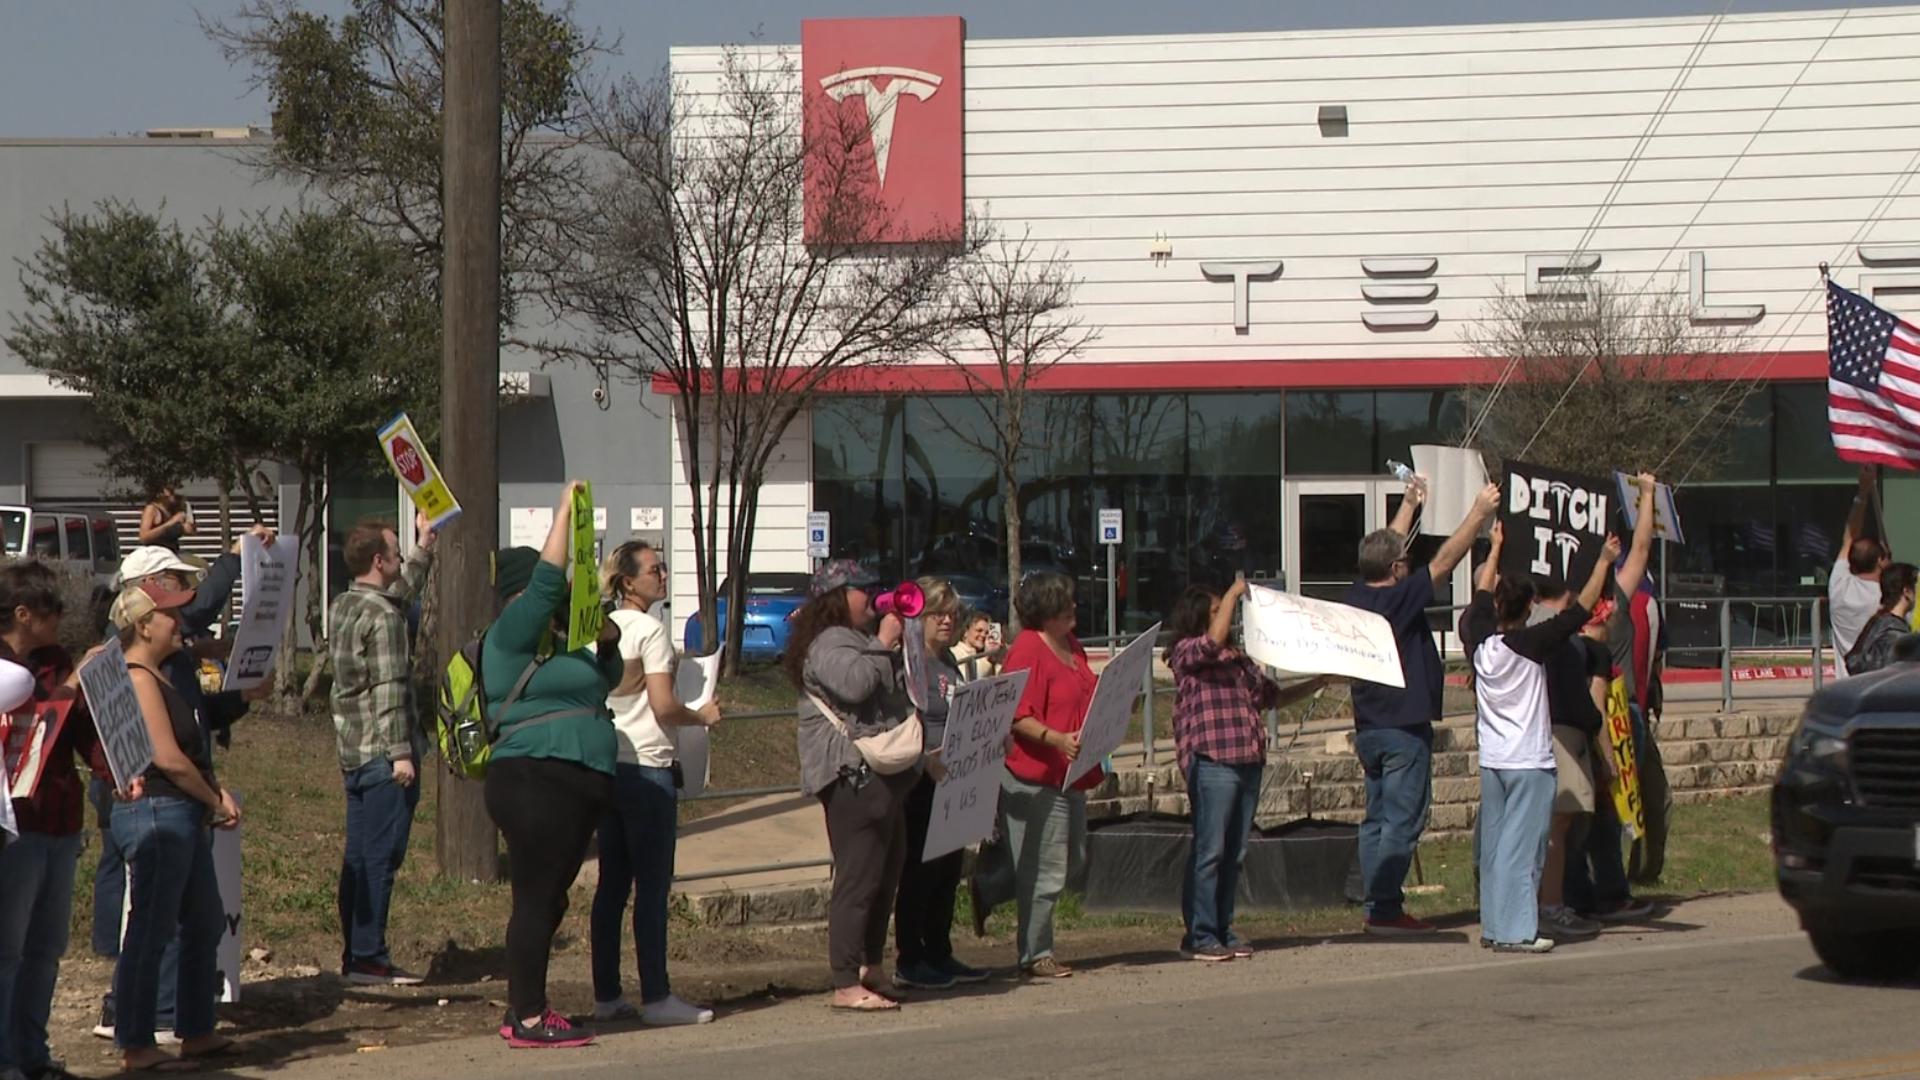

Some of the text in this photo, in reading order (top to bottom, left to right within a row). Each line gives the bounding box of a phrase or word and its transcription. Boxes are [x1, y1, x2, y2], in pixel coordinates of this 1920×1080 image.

[396, 448, 418, 475] STOP
[1509, 472, 1608, 537] DITCH
[1530, 526, 1581, 582] IT
[1732, 669, 1752, 681] FIRE
[1754, 667, 1777, 679] LANE
